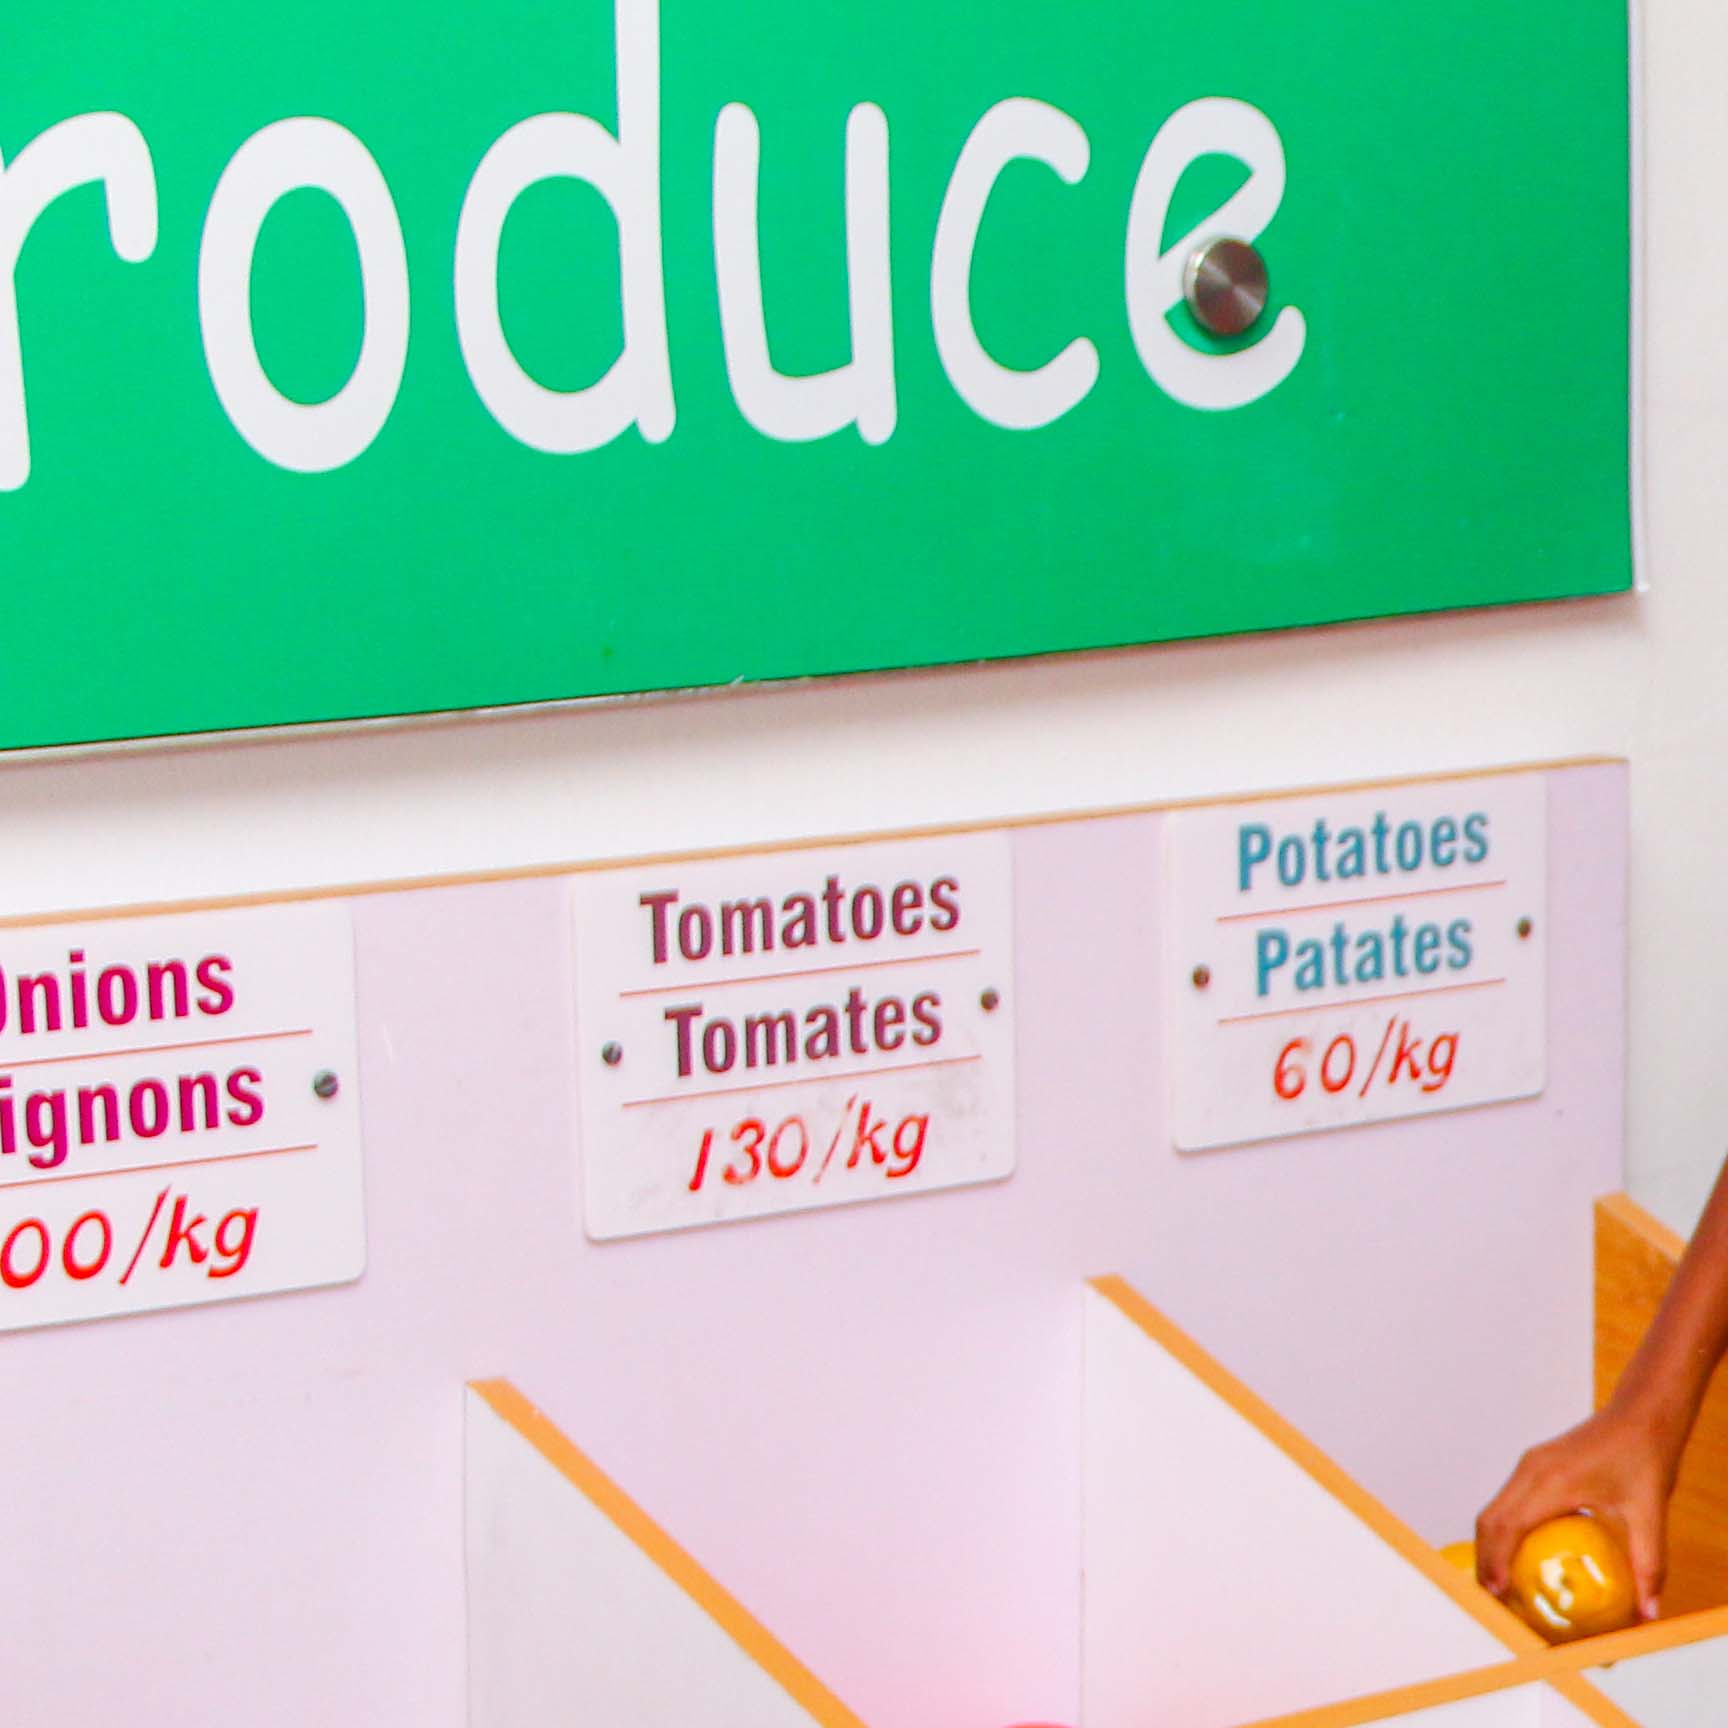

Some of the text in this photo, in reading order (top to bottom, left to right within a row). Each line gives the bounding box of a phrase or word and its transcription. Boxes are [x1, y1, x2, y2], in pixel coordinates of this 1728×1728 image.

[1237, 812, 1490, 892] Potatoes
[639, 875, 960, 965] Tomatoes
[1256, 914, 1473, 998] Patates
[0, 950, 235, 1036] nions
[664, 987, 943, 1079] Tomates
[1272, 1012, 1460, 1100] 60/kg
[689, 1093, 930, 1193] 130/kg
